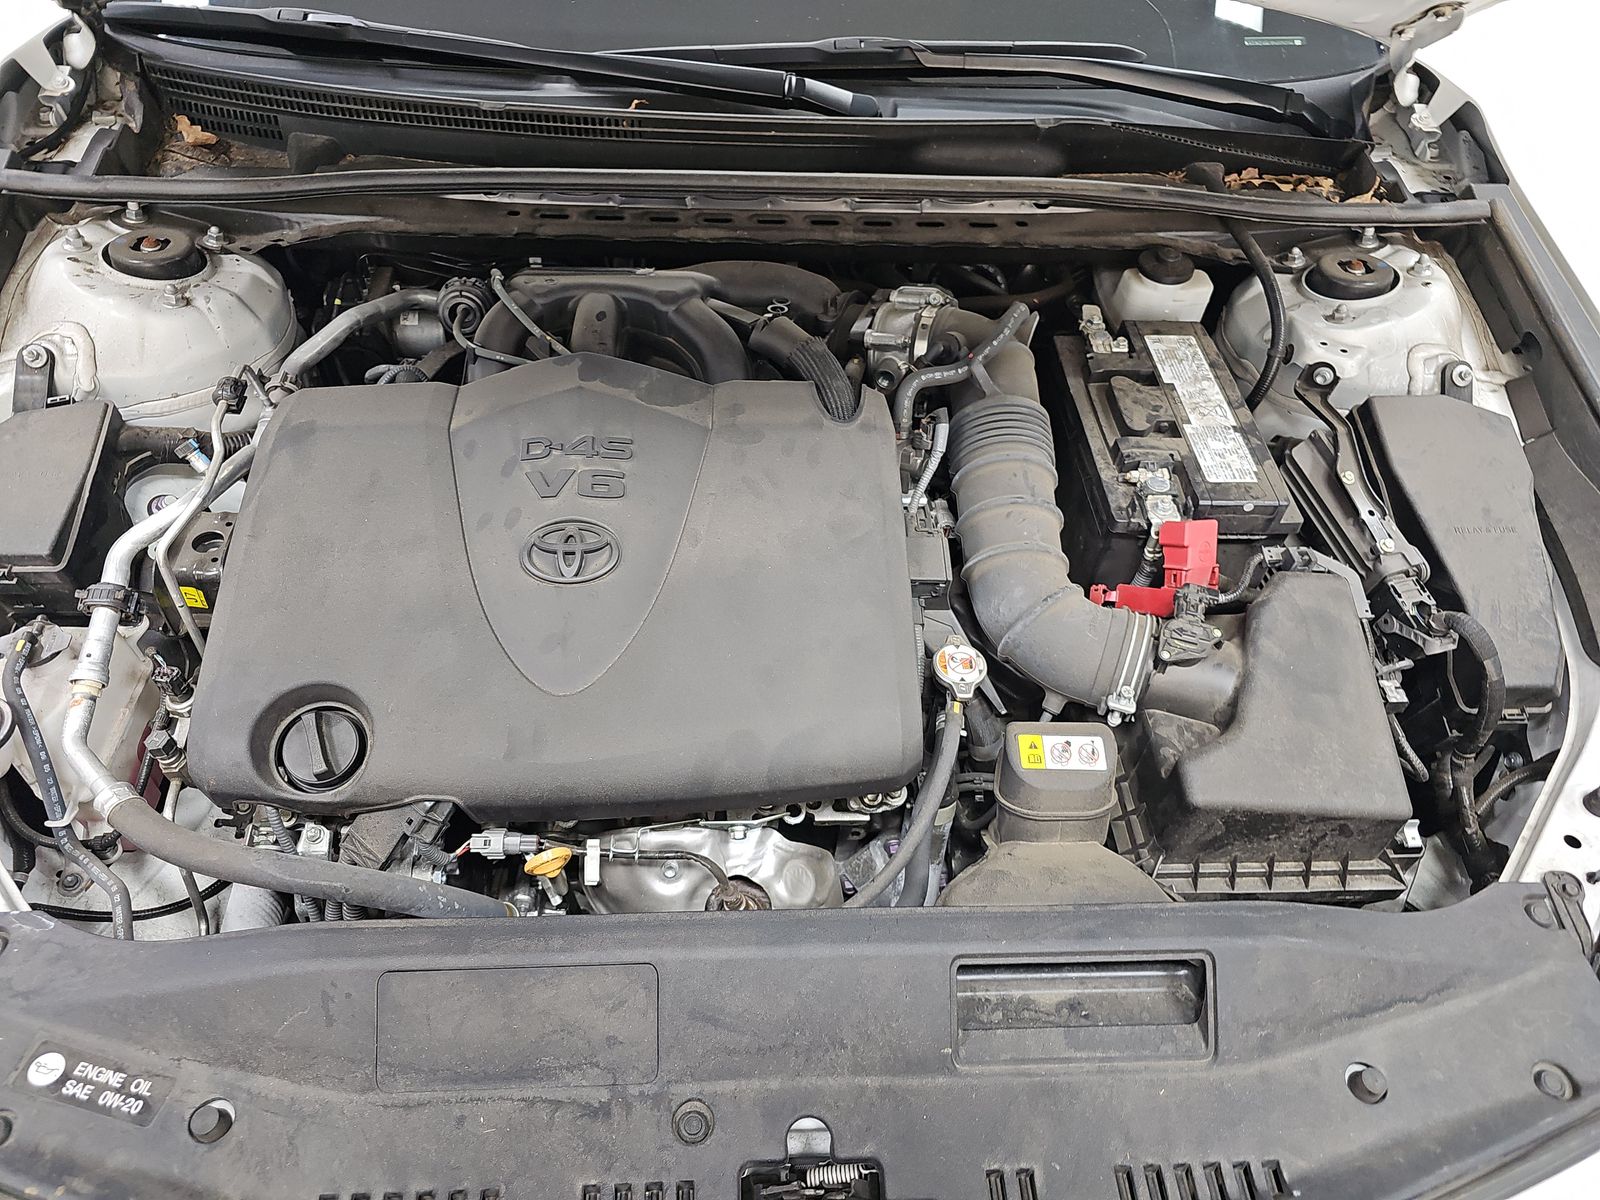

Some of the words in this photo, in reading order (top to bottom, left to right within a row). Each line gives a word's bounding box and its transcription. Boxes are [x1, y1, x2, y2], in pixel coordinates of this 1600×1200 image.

[520, 435, 634, 461] D-4S
[525, 469, 625, 498] V6
[61, 1079, 95, 1101] SAE
[73, 1061, 127, 1088] ENGINE
[130, 1078, 153, 1097] OIL
